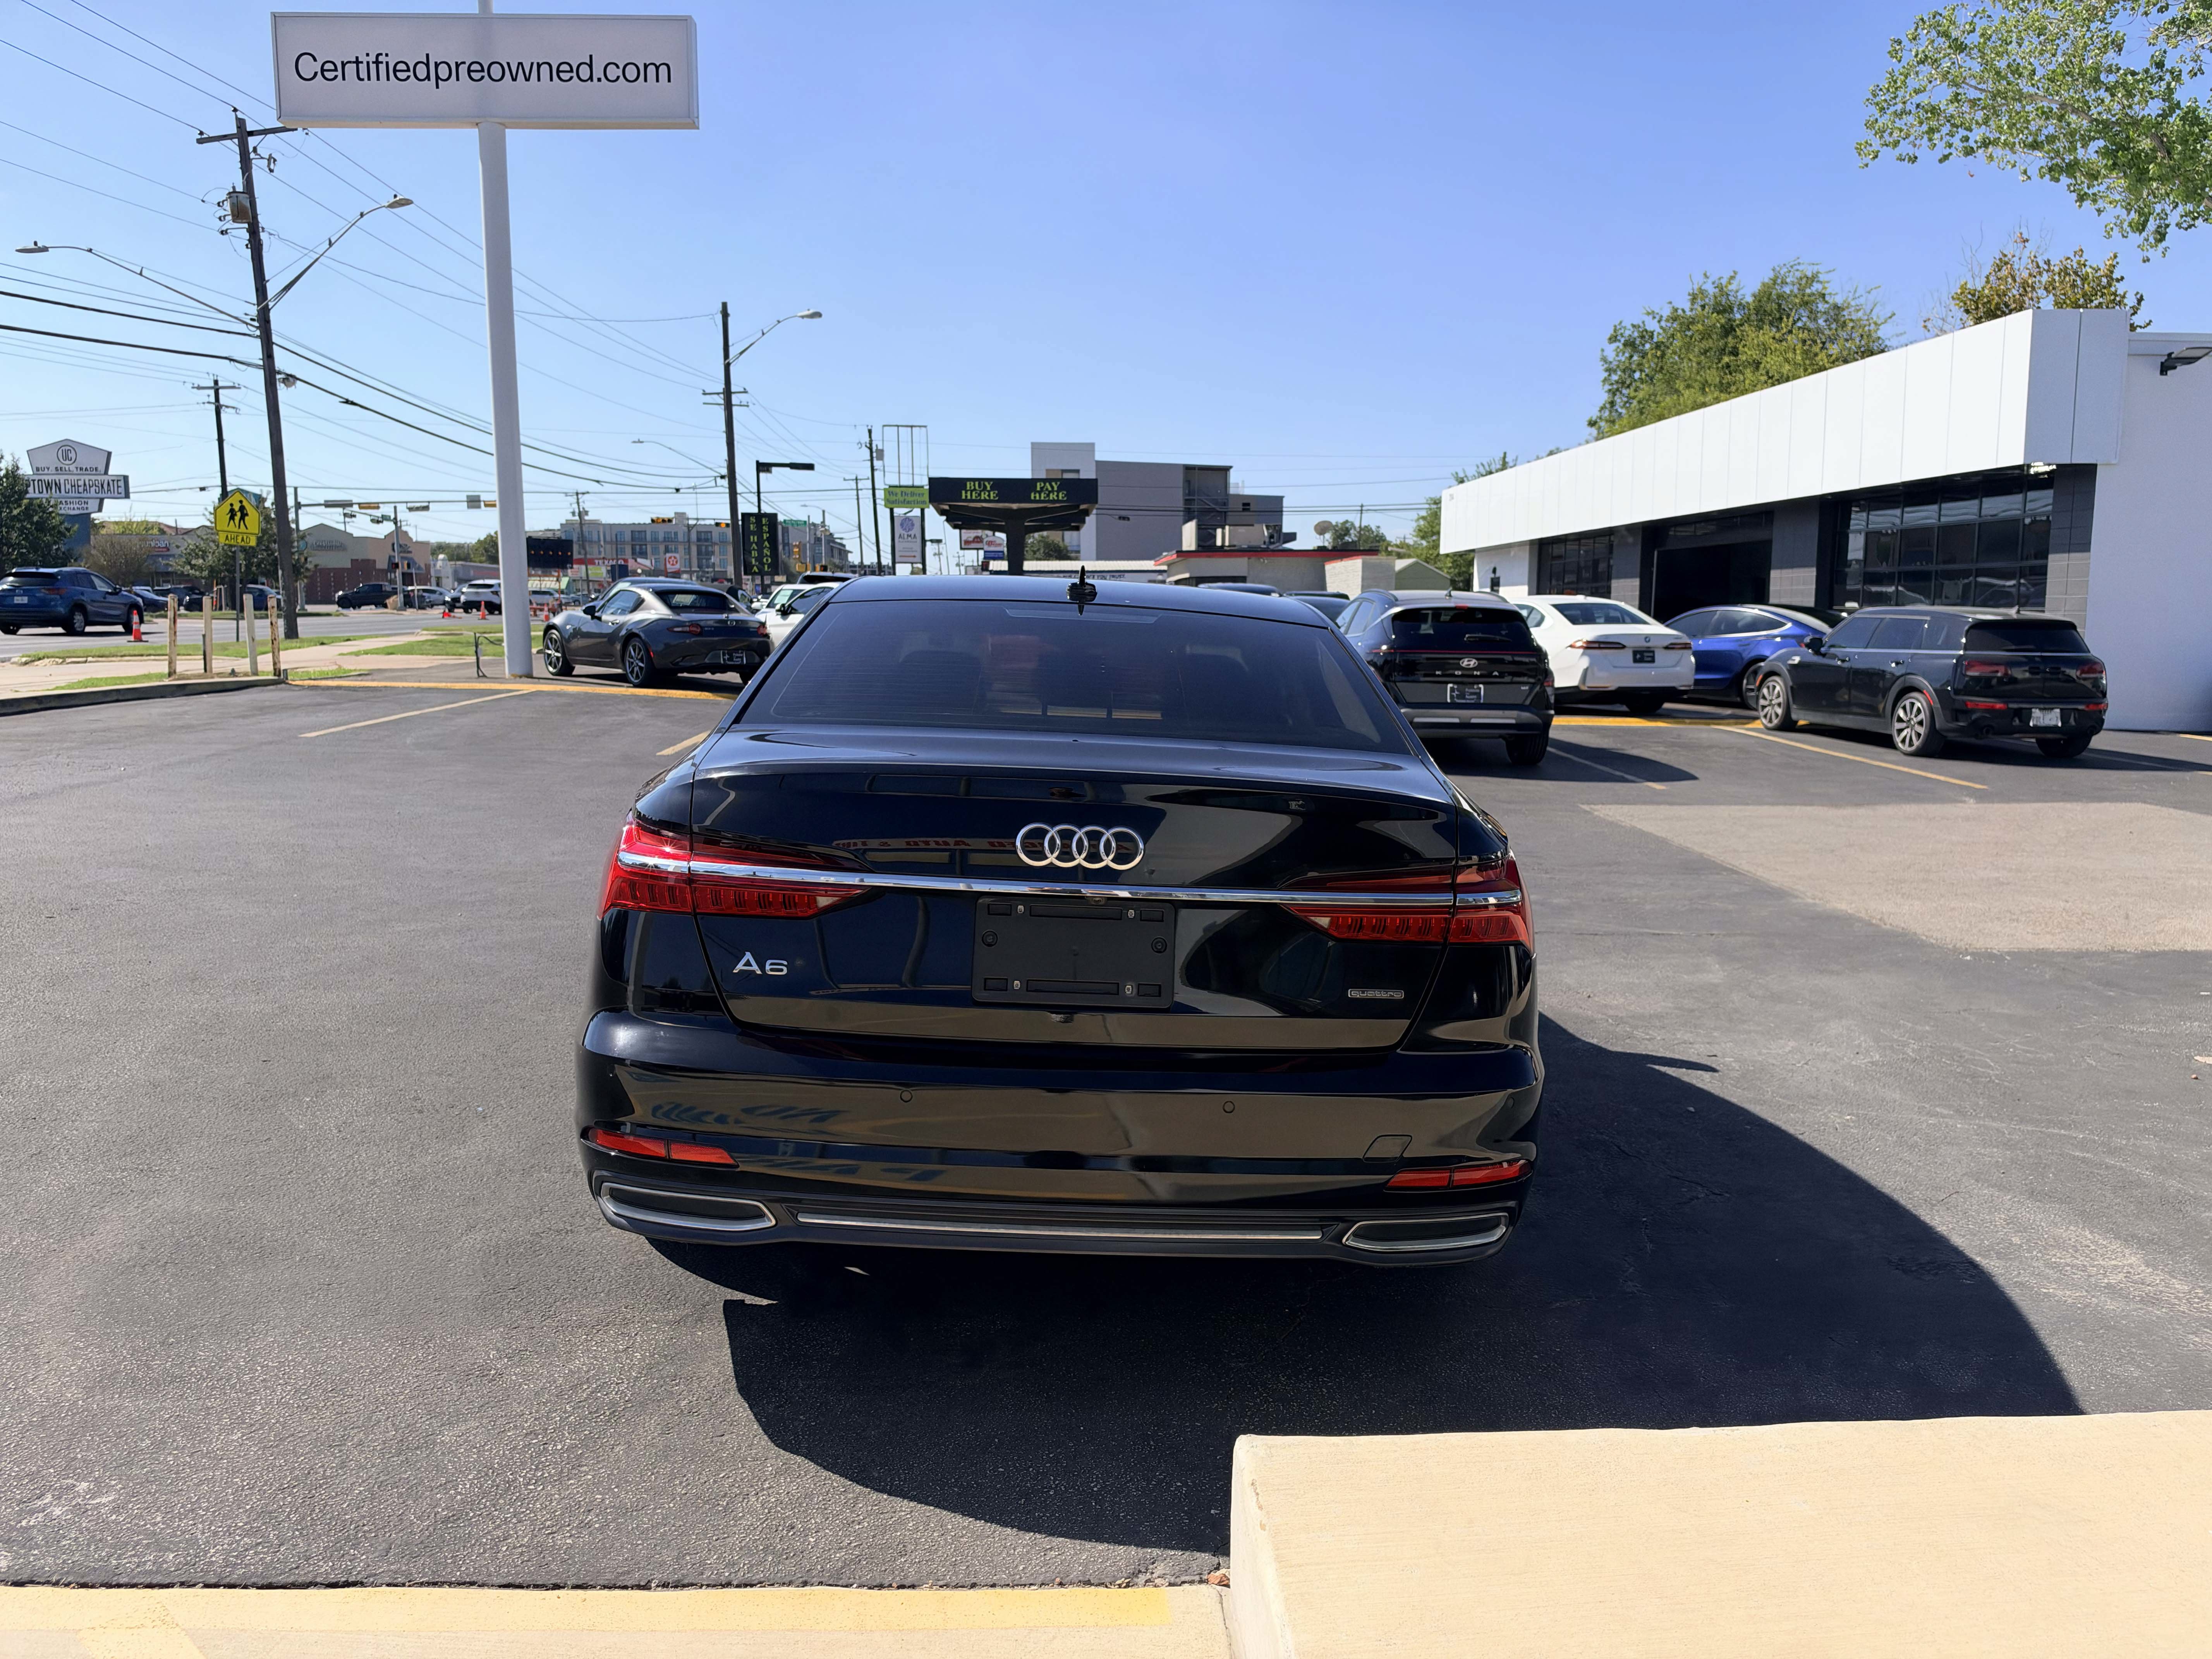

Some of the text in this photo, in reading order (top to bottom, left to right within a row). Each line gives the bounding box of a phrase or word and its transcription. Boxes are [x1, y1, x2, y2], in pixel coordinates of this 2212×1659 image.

[295, 52, 672, 89] Certifiedpreowned.com
[62, 449, 72, 461] UC
[28, 478, 122, 495] TOWN CHEAPSKATE
[966, 481, 993, 491] BUY
[1036, 482, 1060, 491] PAY
[962, 490, 999, 500] HERE
[1030, 491, 1067, 500] HERE
[225, 535, 251, 544] AHEAD
[750, 516, 759, 573] SE HABLA
[762, 517, 771, 572] ESPAÑOL
[733, 951, 788, 975] A6
